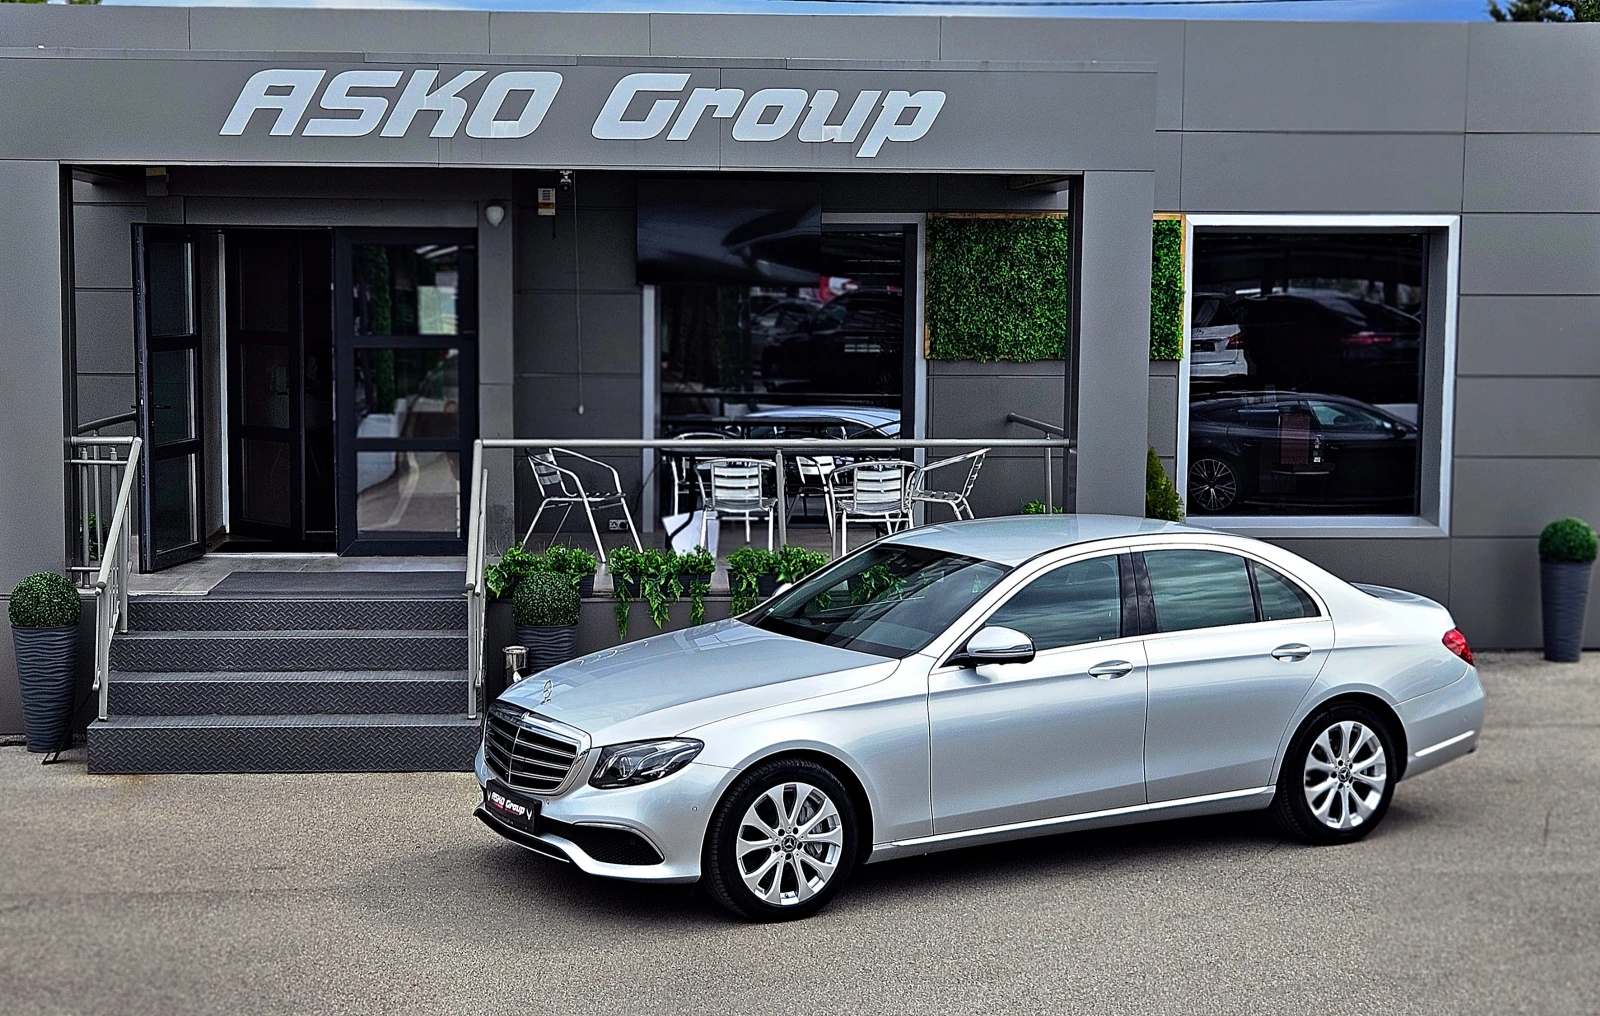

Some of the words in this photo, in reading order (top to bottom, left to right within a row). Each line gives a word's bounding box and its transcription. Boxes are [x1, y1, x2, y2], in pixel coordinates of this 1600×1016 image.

[219, 69, 563, 139] ASKO
[591, 72, 947, 158] Group
[505, 799, 525, 815] Group
